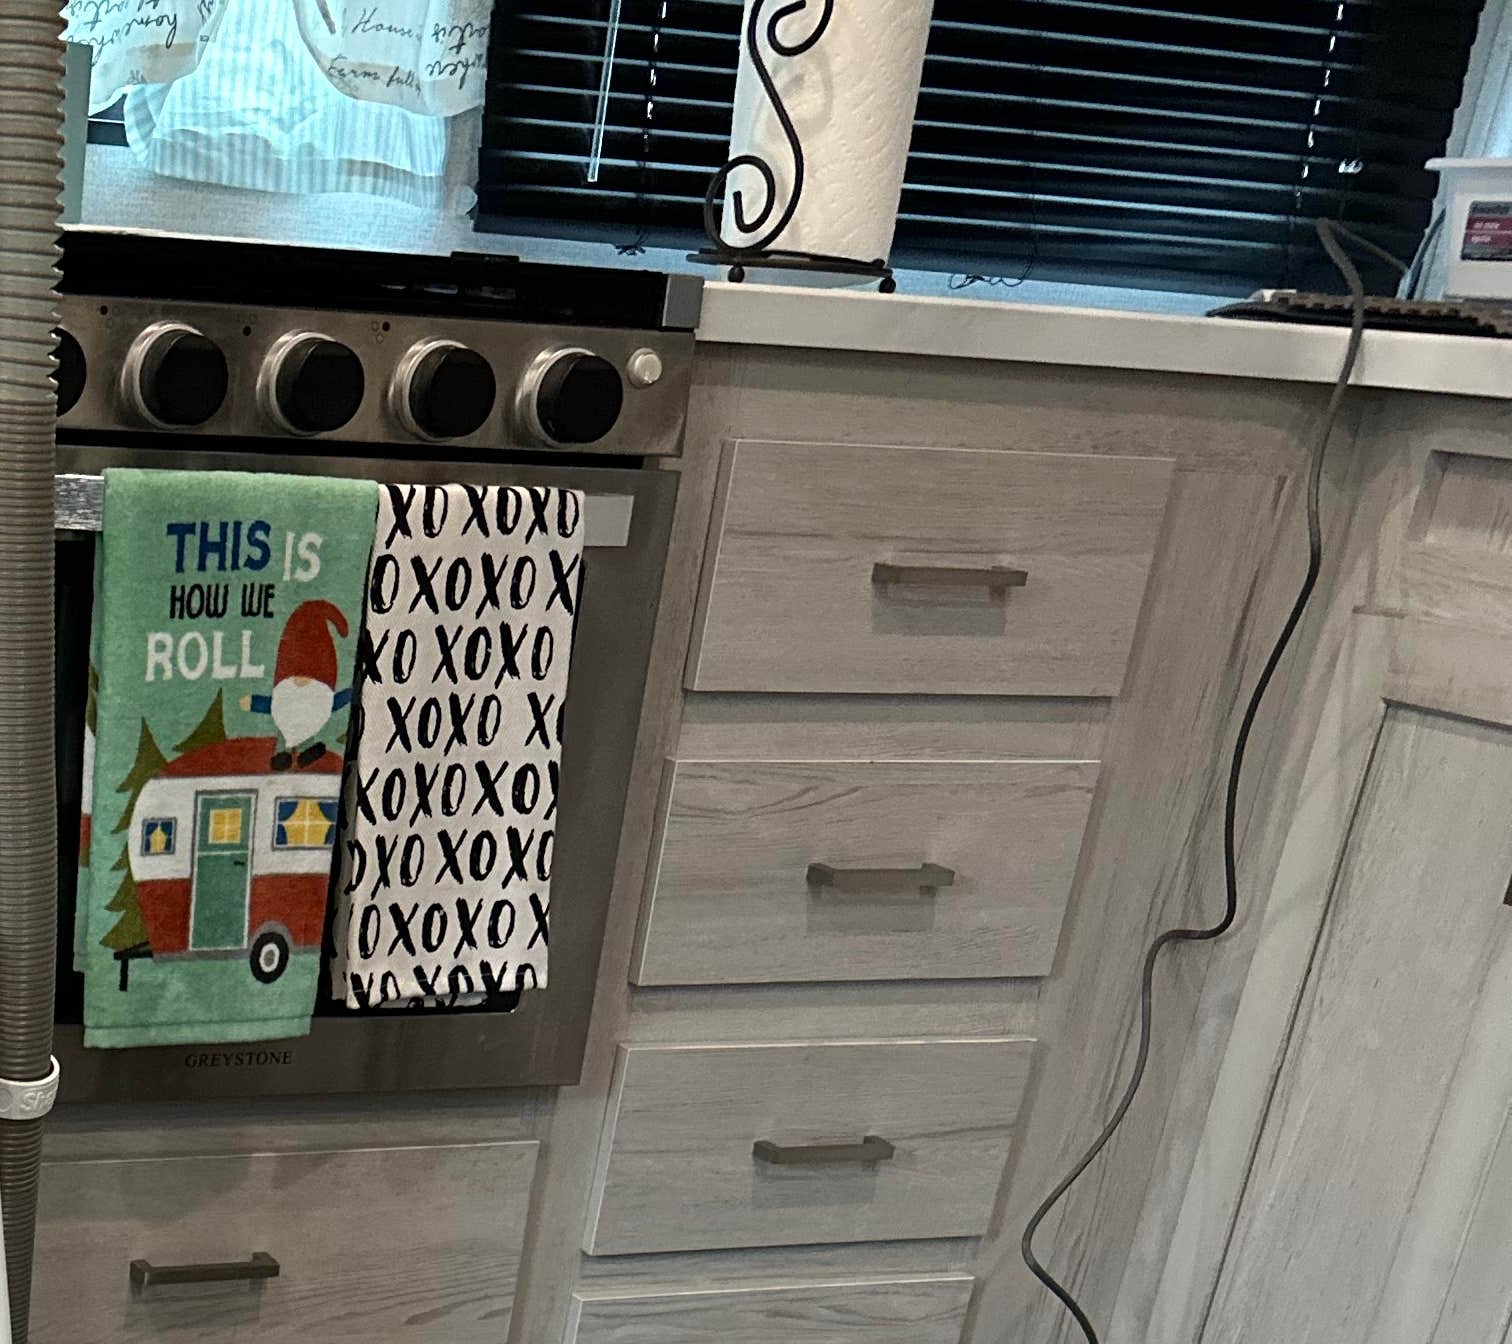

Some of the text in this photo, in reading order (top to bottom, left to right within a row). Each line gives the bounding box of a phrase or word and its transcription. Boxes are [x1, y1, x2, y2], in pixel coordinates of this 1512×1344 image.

[166, 520, 323, 582] THIS IS
[169, 582, 276, 620] HOW WE
[145, 630, 265, 682] ROLL
[185, 1050, 292, 1068] GREYSTONE
